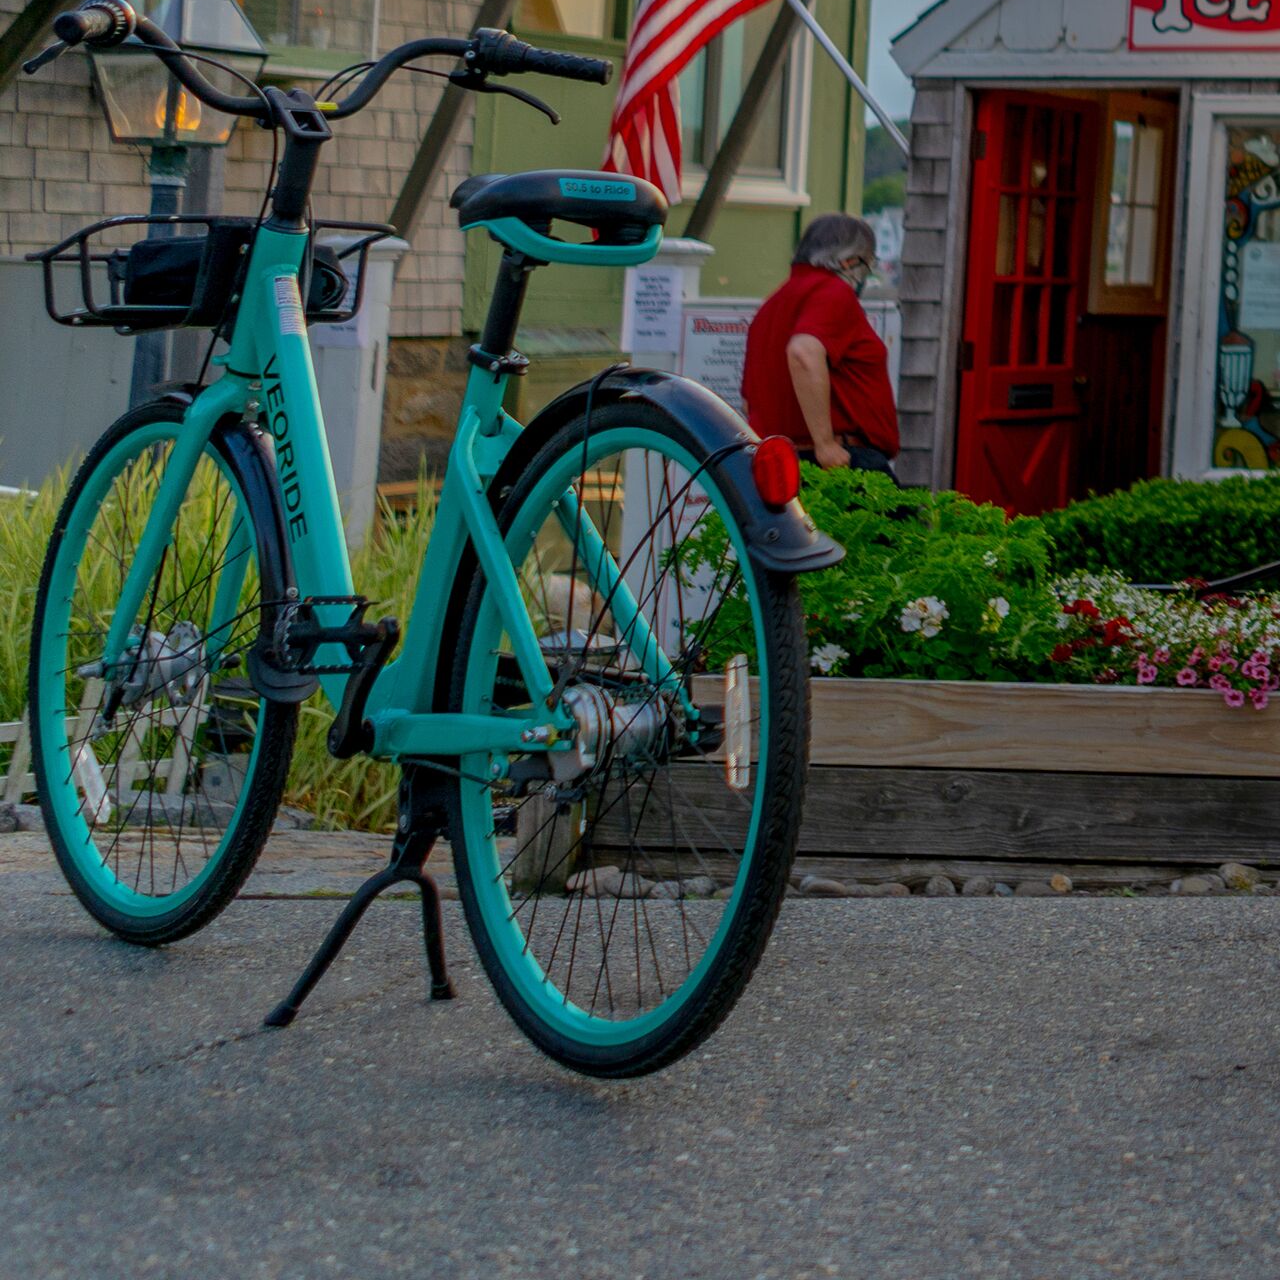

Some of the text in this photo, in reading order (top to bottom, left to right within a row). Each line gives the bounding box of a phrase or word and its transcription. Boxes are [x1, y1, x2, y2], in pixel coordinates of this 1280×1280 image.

[590, 184, 601, 194] to
[604, 184, 631, 196] Ride
[263, 353, 308, 544] VEORIDE
